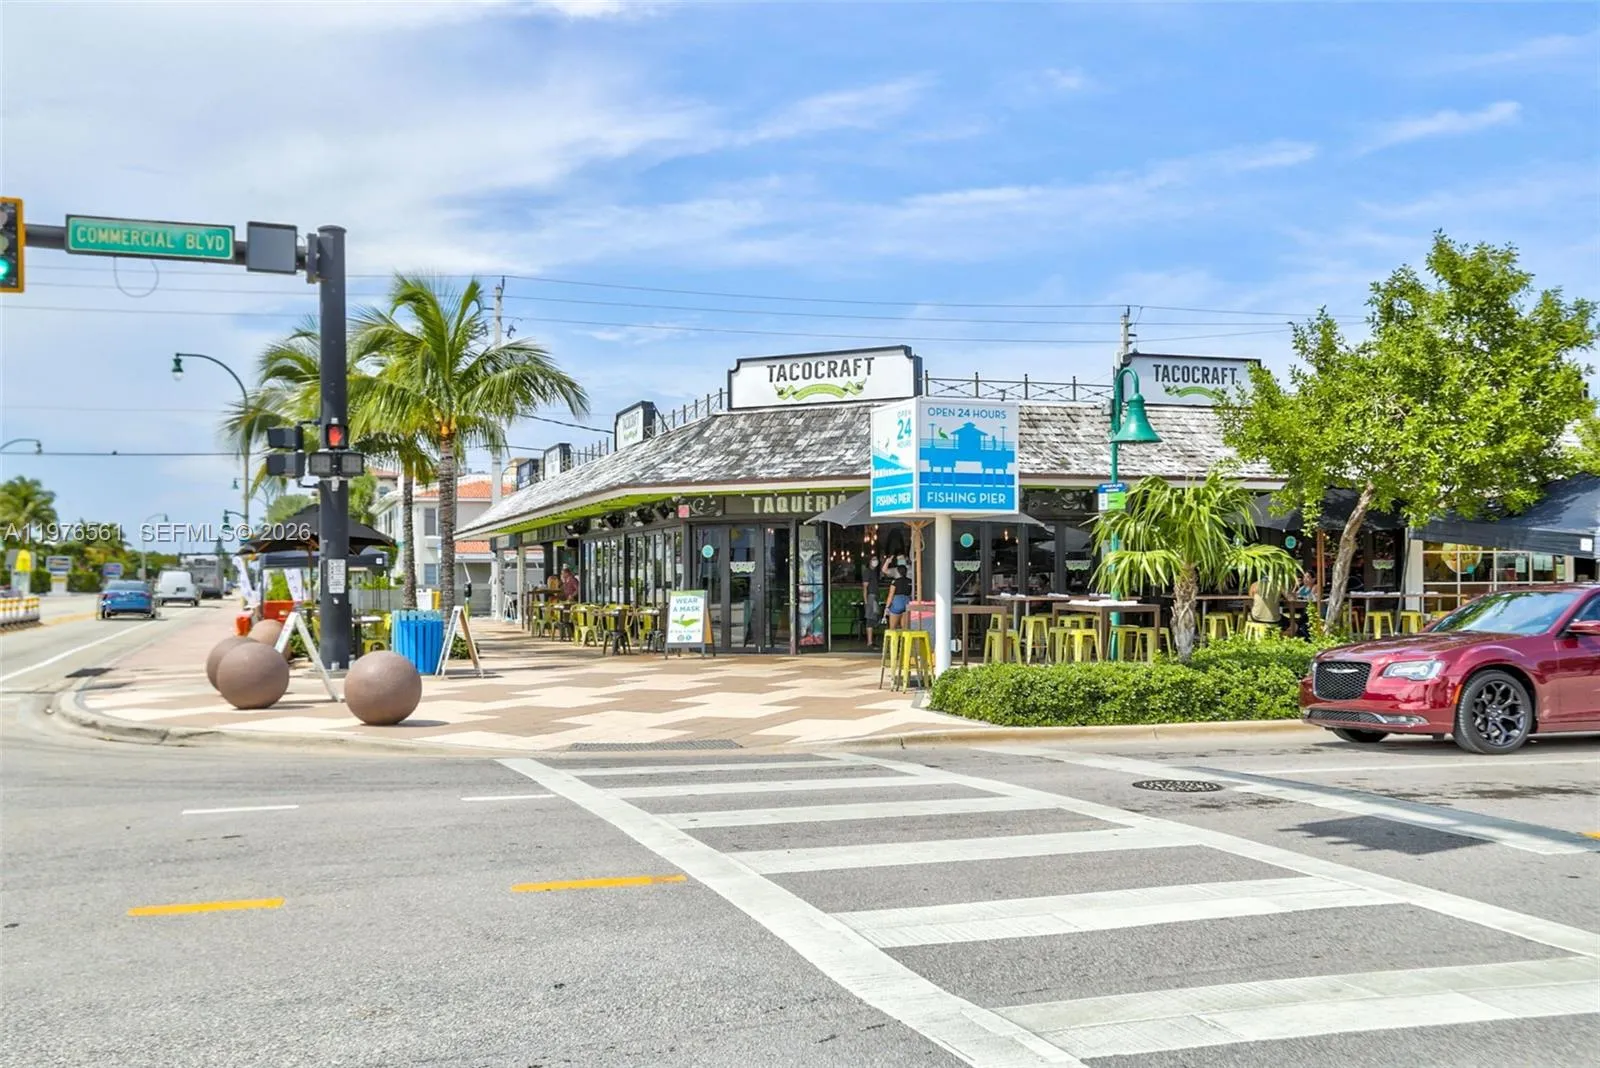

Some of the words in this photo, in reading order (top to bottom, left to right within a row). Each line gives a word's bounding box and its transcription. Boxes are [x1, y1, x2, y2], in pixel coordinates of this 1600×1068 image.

[76, 226, 175, 248] COMMERCIAL
[185, 232, 225, 251] BLVD
[766, 357, 875, 383] TACOCRAFT
[1152, 364, 1238, 385] TACOCRAFT
[928, 407, 955, 417] OPEN
[957, 408, 971, 418] 24
[973, 408, 1006, 419] HOURS
[897, 418, 912, 440] 24
[927, 491, 977, 504] FISHING
[979, 492, 1006, 504] PIER
